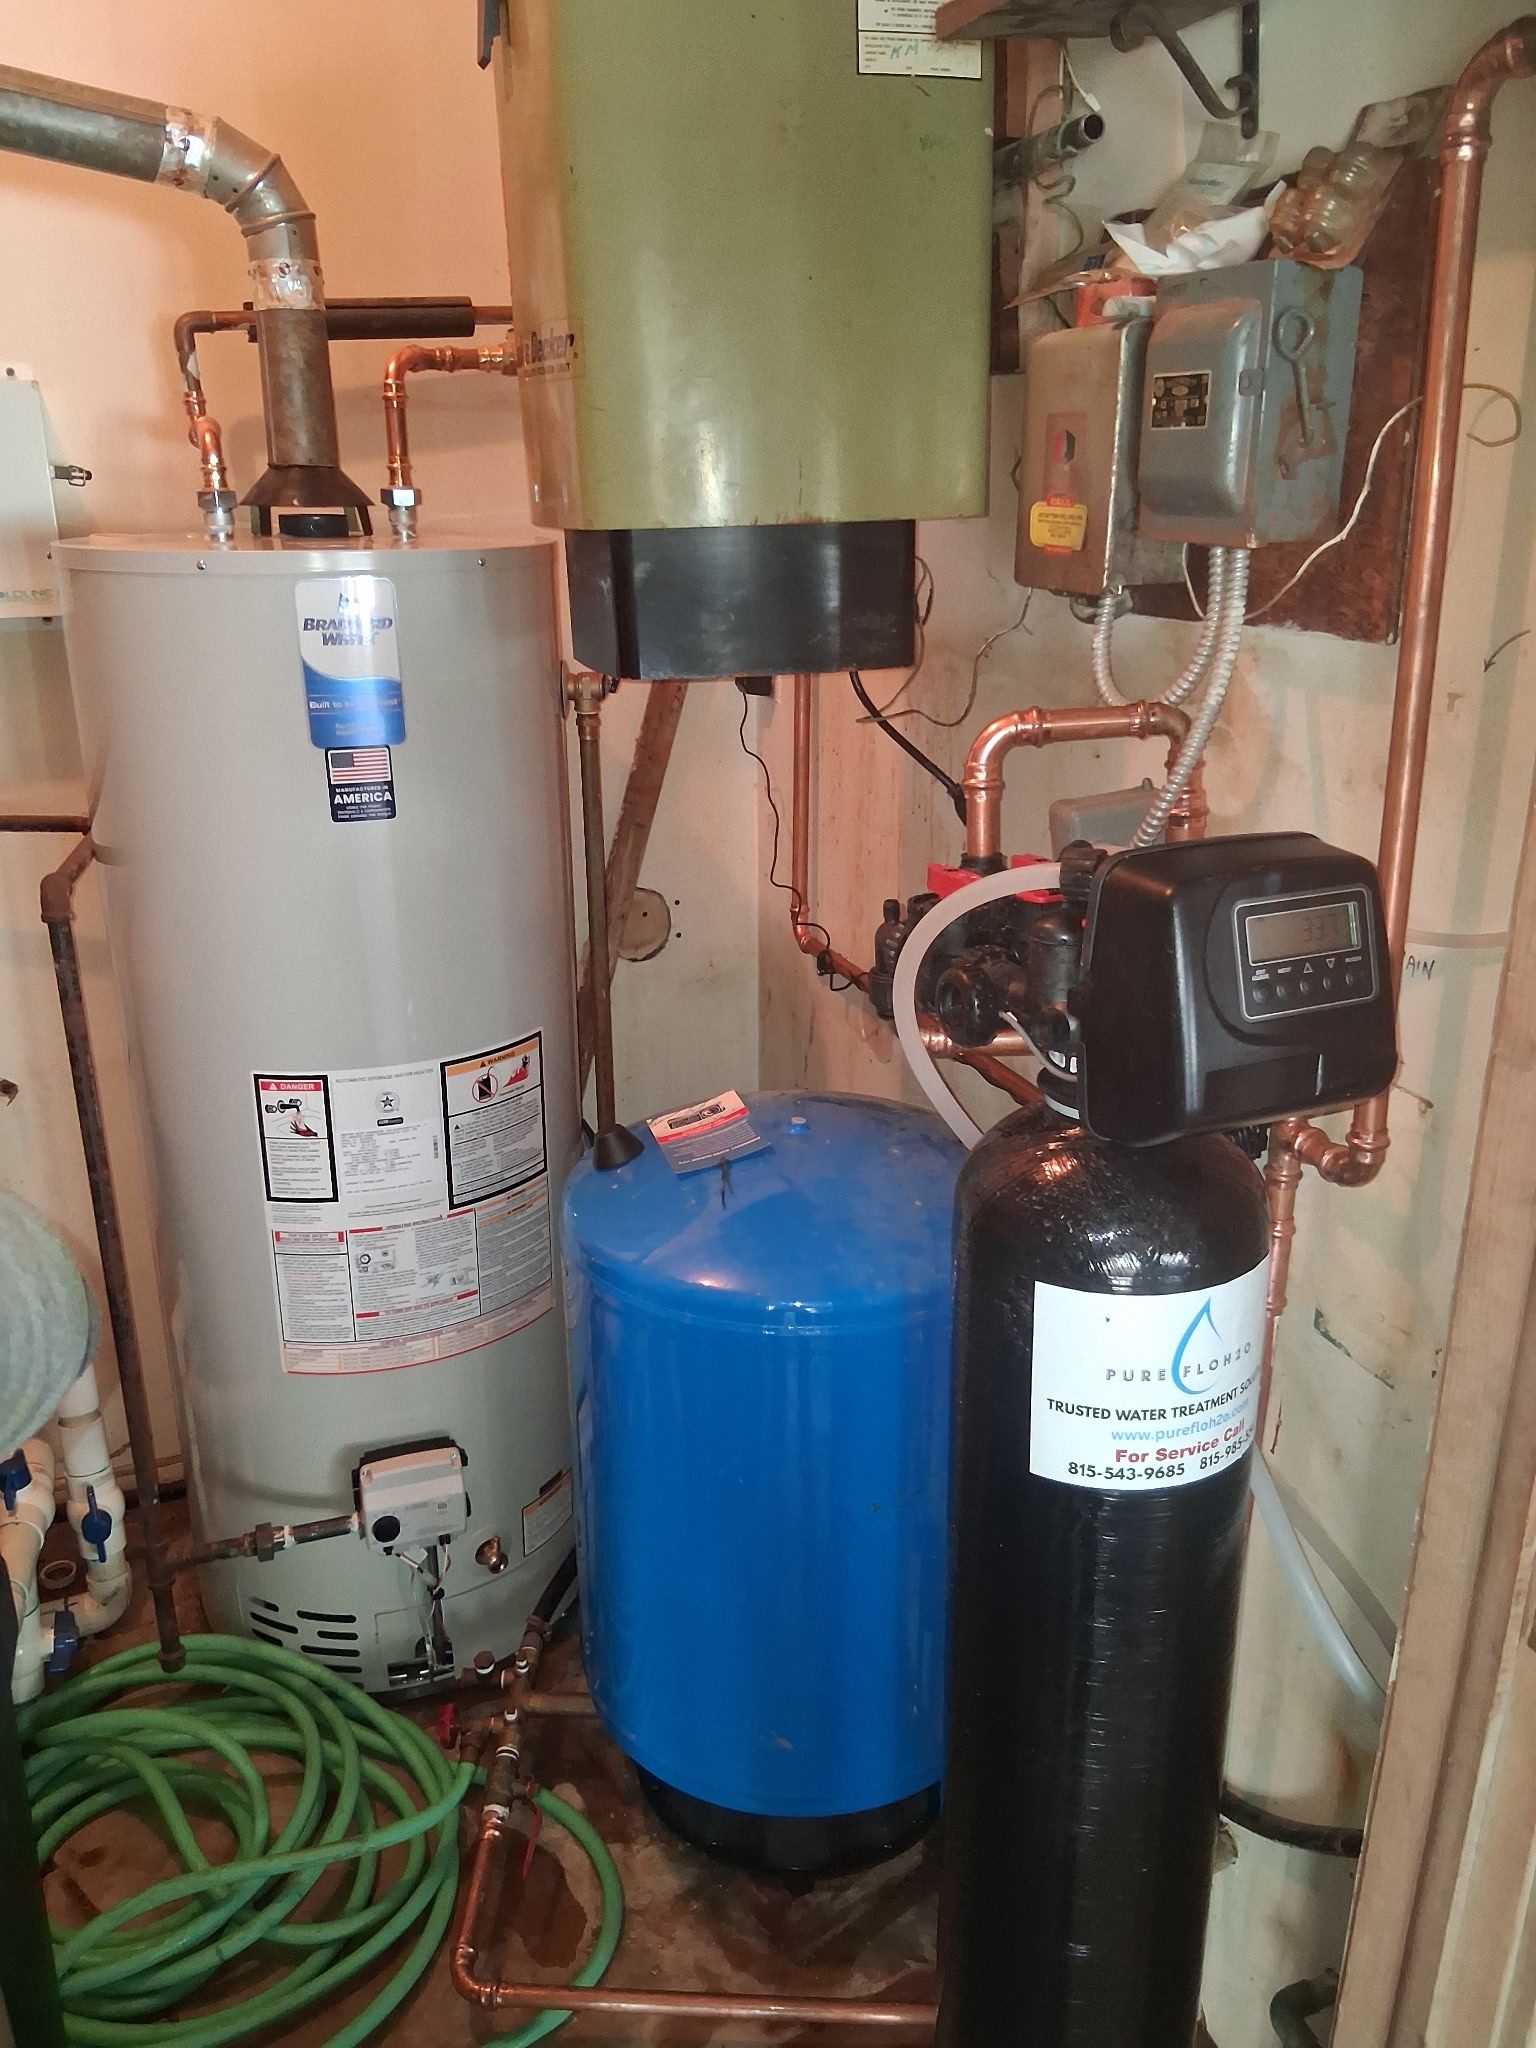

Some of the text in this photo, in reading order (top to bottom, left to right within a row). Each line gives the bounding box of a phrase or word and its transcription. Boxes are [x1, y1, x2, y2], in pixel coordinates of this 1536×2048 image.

[303, 618, 393, 632] BRADRD
[309, 700, 331, 710] Built
[333, 791, 393, 805] AMERICA
[1105, 1341, 1252, 1382] PURE FLOH2O
[1046, 1397, 1112, 1420] TRUSTED
[1115, 1408, 1168, 1421] WATER
[1170, 1386, 1239, 1419] TREATMENT
[1115, 1417, 1245, 1463] For Service Call
[1067, 1460, 1186, 1481] 815-543-9685
